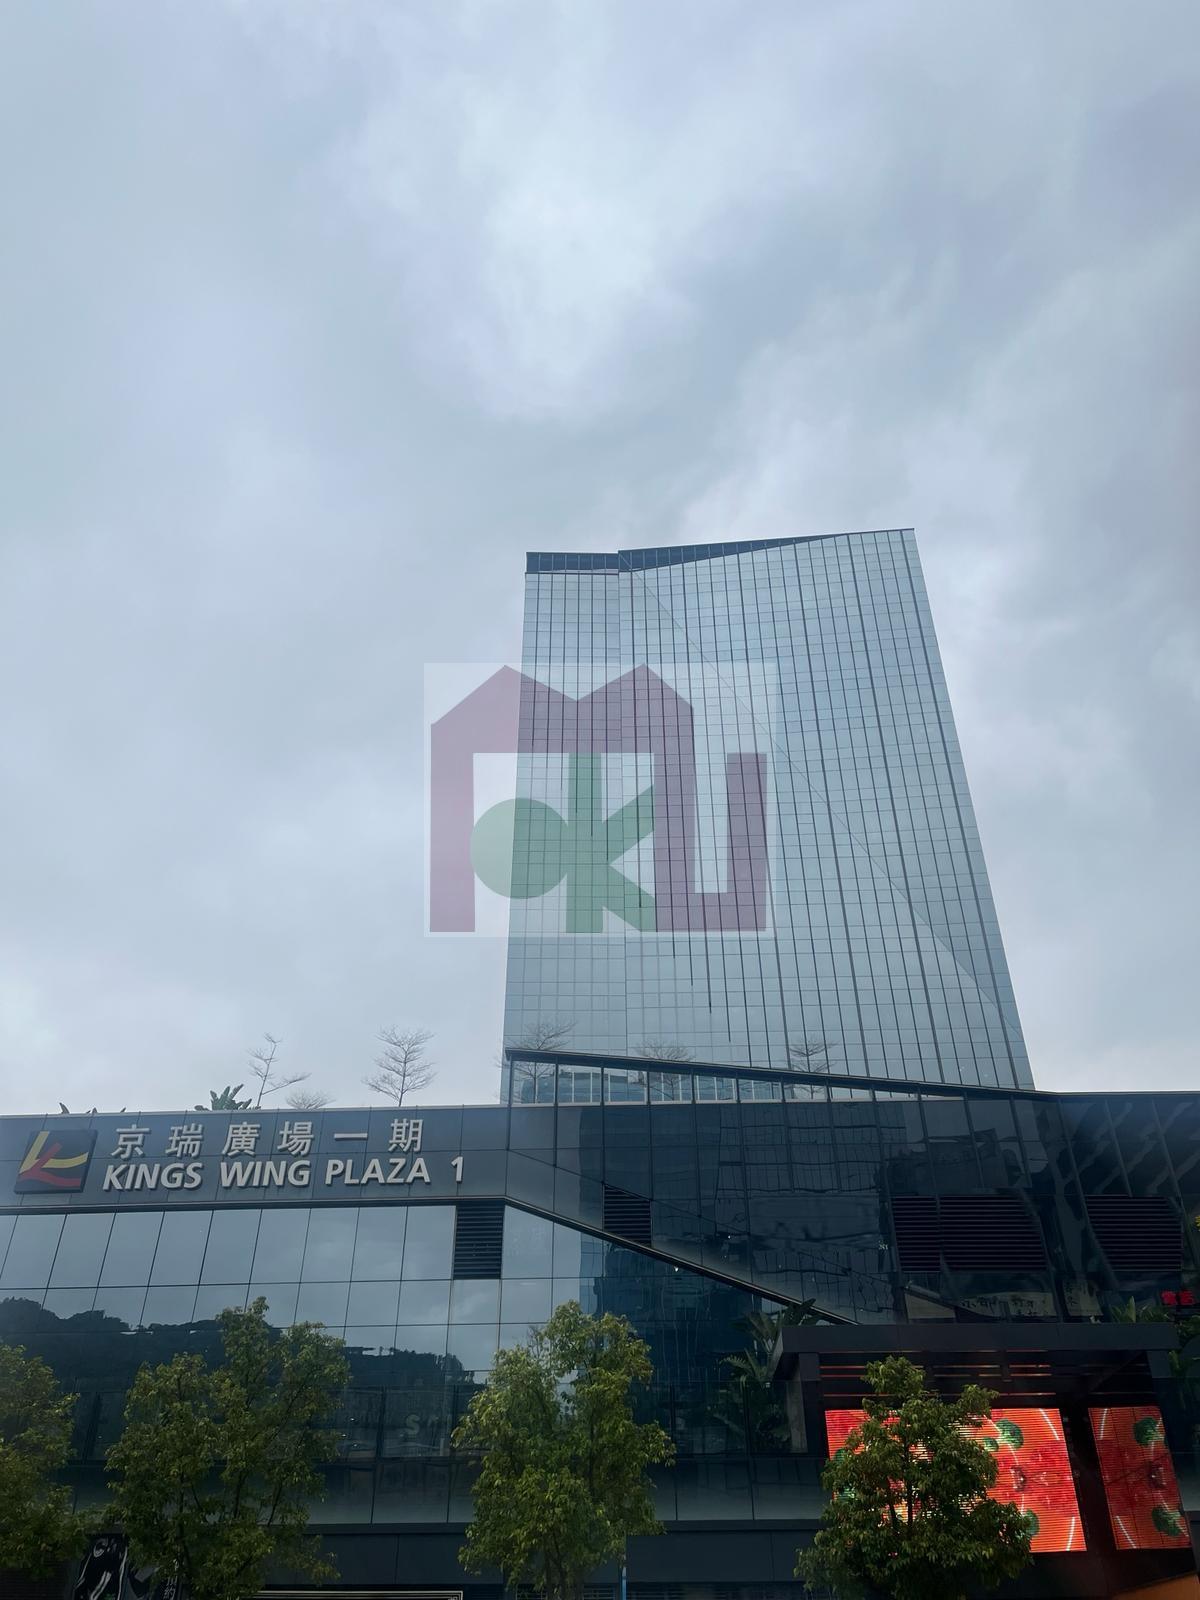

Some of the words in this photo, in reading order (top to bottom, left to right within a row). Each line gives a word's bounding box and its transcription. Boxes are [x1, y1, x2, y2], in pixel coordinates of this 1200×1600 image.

[111, 1118, 423, 1159] 京瑞廣場一期
[102, 1162, 203, 1191] KINGS
[220, 1160, 311, 1187] WING
[325, 1157, 431, 1185] PLAZA
[451, 1156, 464, 1183] 1
